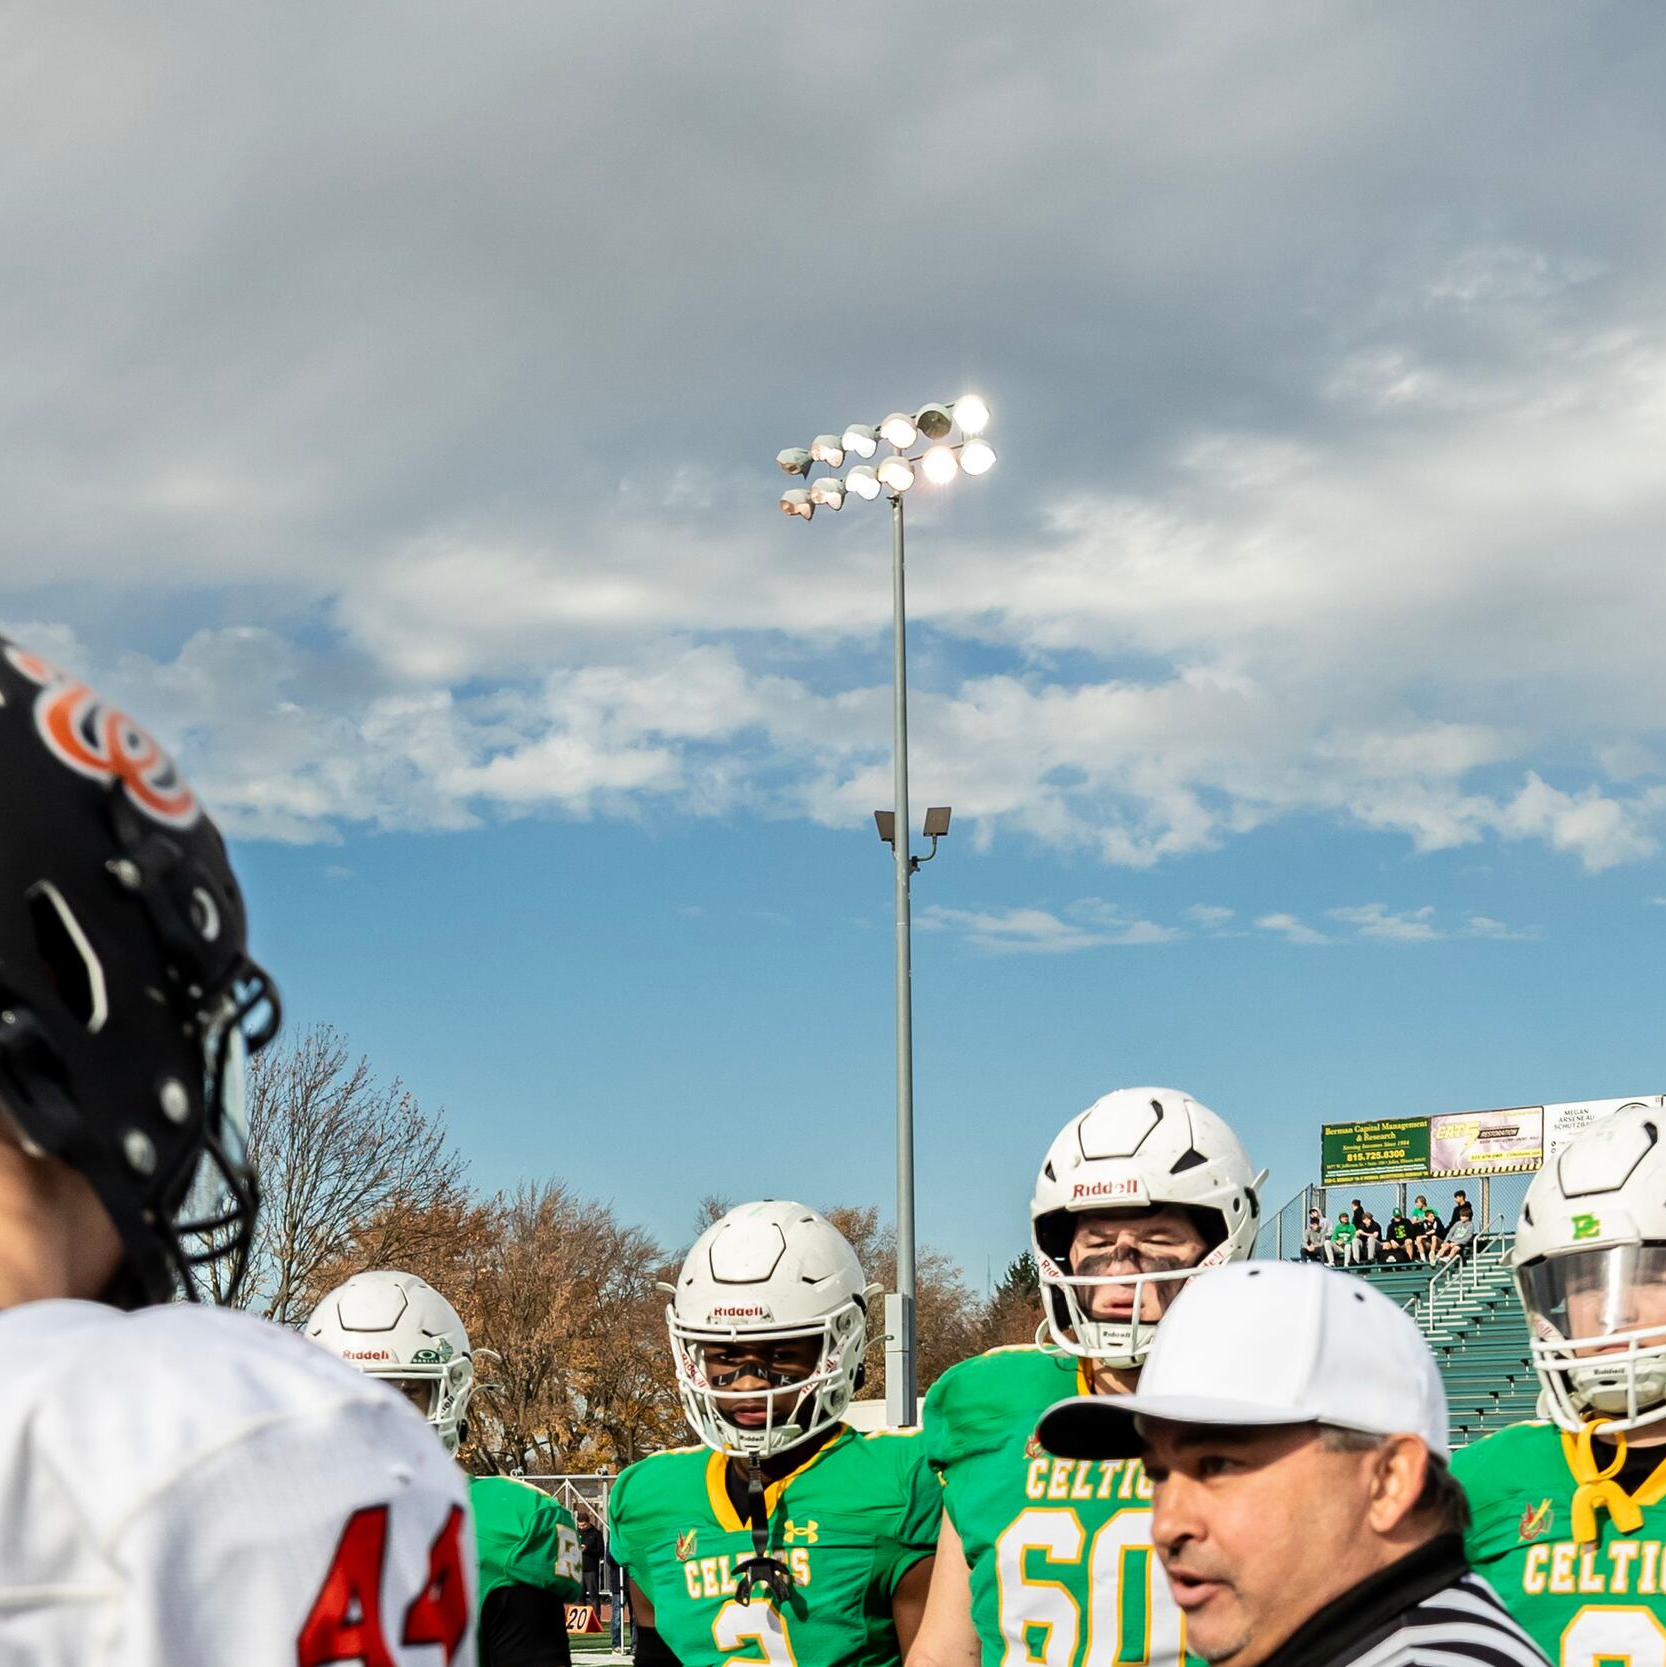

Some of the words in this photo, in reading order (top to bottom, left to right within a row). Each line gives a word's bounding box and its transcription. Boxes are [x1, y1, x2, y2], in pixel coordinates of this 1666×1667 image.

[1325, 1127, 1353, 1136] Berman
[1354, 1124, 1380, 1133] Capital
[1382, 1120, 1428, 1131] Management
[1364, 1131, 1396, 1141] Research
[1074, 1180, 1138, 1198] Riddell
[714, 1306, 764, 1317] Riddell
[343, 1349, 389, 1361] Riddell
[566, 1608, 588, 1630] 20
